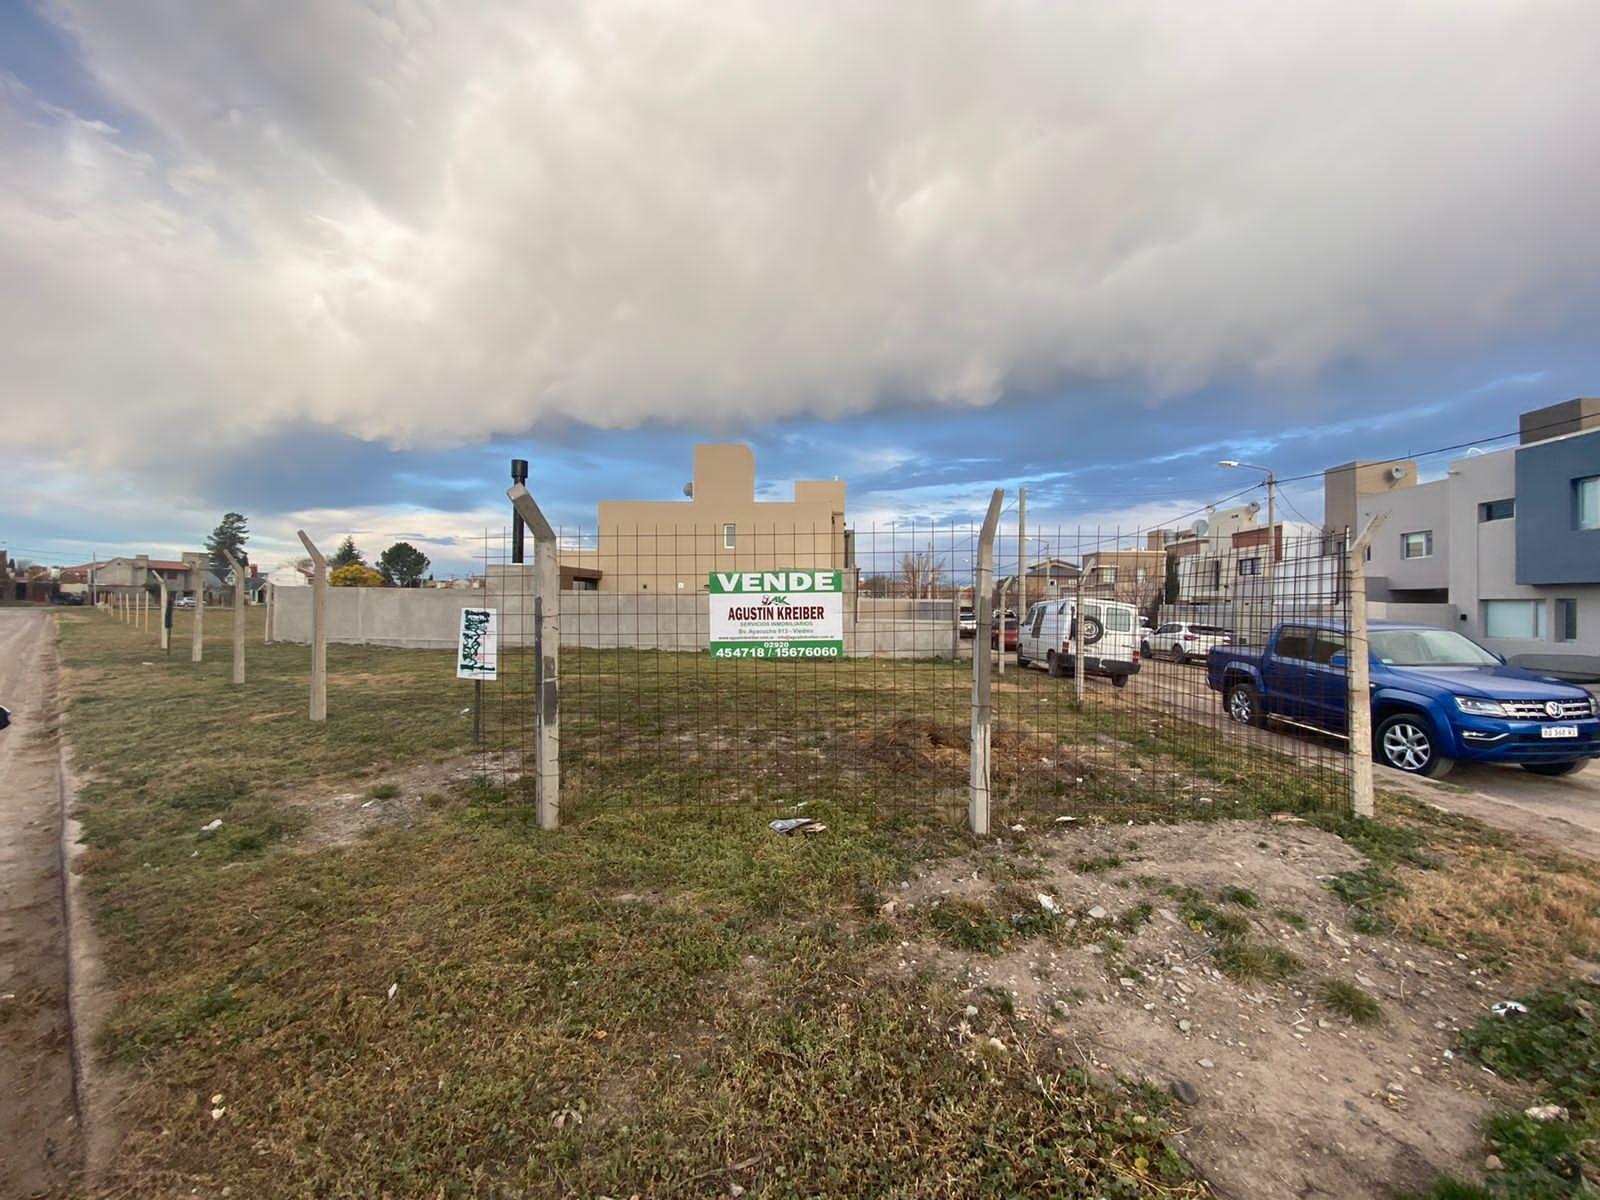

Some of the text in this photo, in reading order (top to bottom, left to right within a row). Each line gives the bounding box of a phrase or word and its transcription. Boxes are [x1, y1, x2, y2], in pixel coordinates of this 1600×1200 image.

[717, 572, 833, 591] VENDE
[728, 606, 824, 621] AGUSTIN KREIBER
[716, 648, 764, 657] 454718
[775, 647, 837, 657] 15676060
